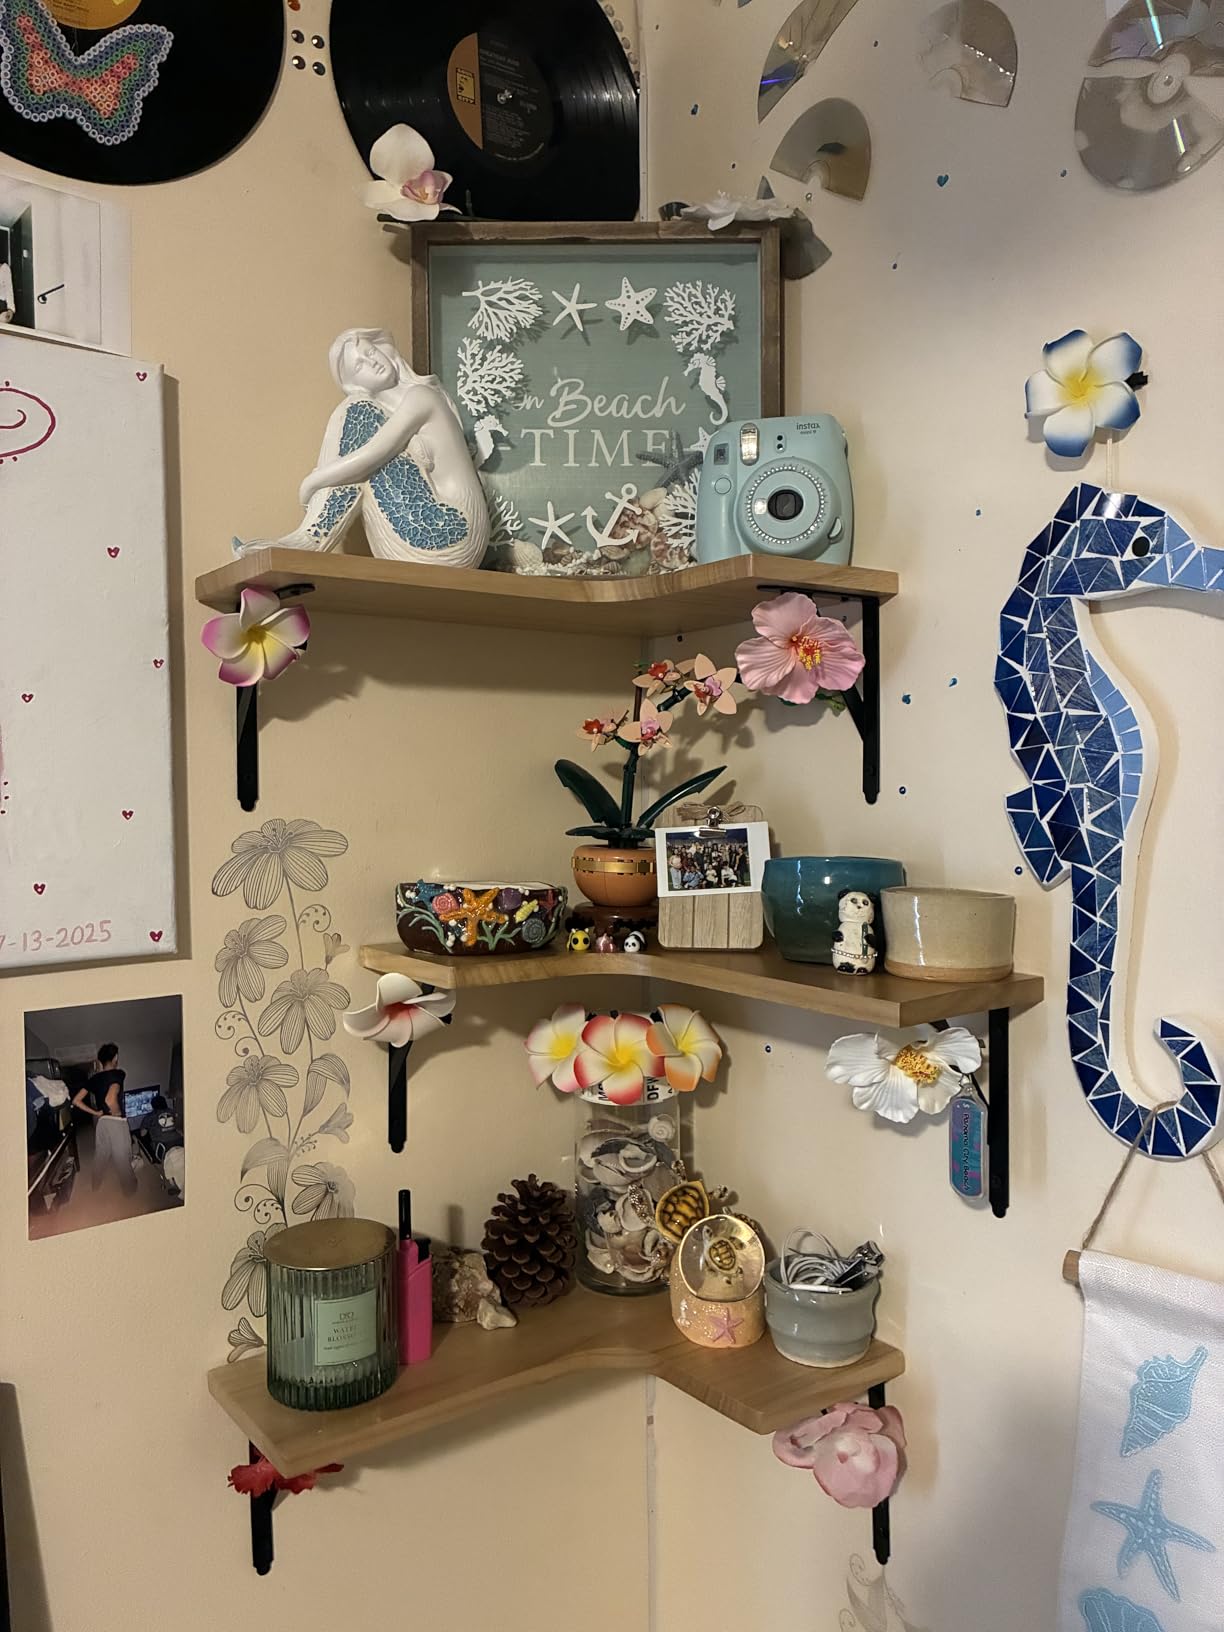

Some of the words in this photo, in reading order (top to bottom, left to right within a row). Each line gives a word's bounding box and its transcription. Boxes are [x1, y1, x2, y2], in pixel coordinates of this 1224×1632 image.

[547, 376, 686, 427] Beach
[796, 422, 820, 430] instax
[520, 428, 670, 467] TIME
